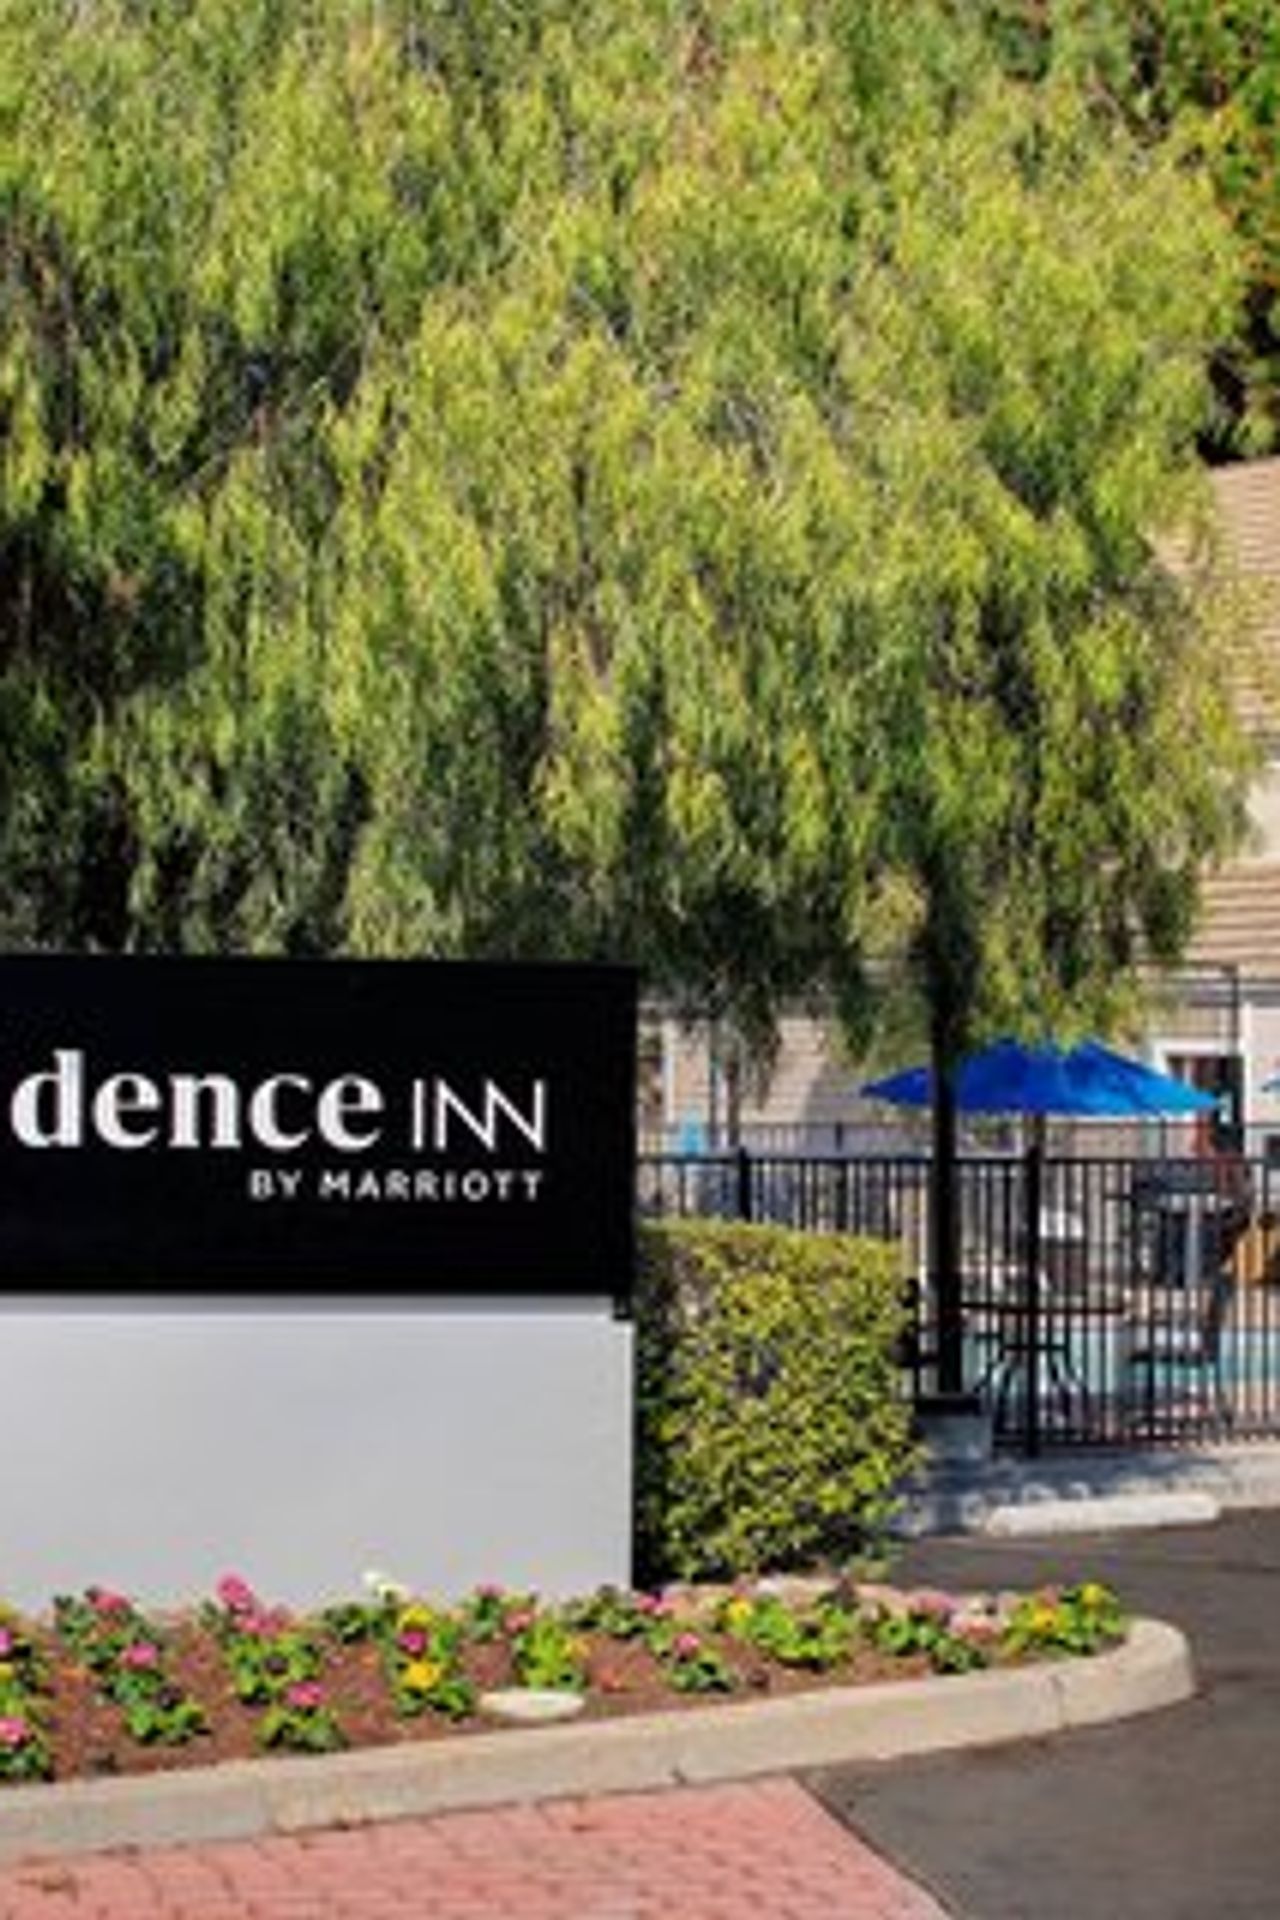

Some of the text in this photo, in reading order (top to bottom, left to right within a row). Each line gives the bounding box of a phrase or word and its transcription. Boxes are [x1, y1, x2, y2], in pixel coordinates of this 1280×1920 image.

[10, 1048, 546, 1151] dence INN
[250, 1170, 543, 1201] BY MARRIOTT
